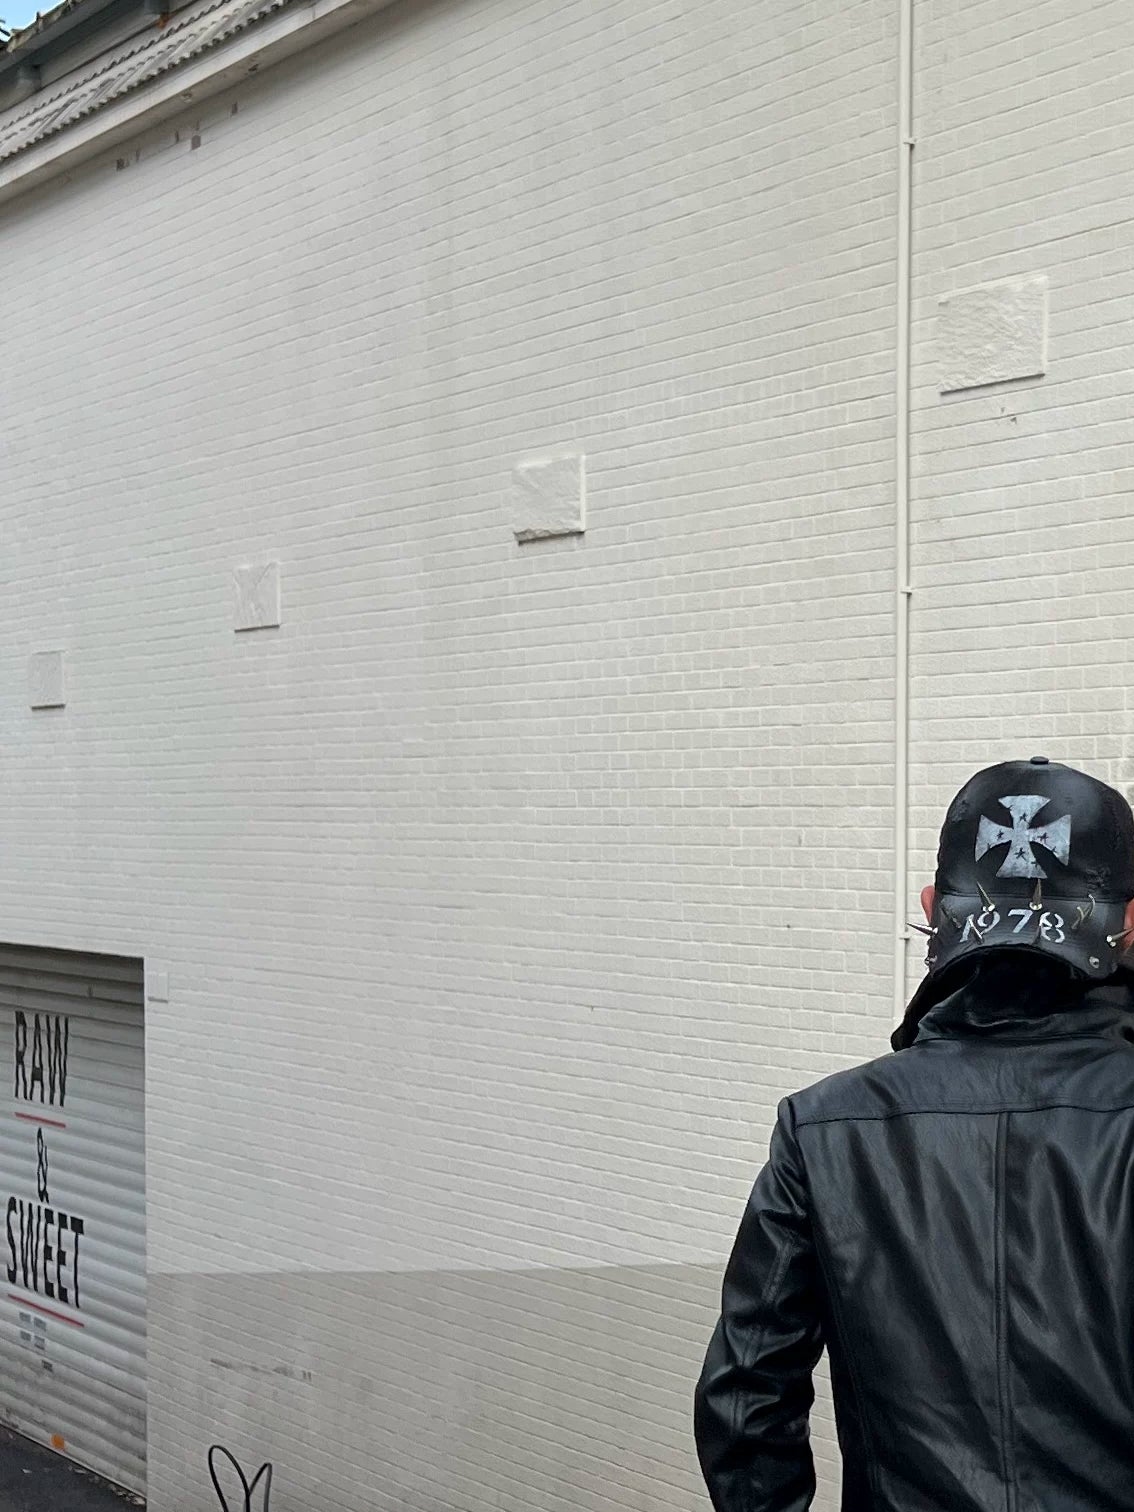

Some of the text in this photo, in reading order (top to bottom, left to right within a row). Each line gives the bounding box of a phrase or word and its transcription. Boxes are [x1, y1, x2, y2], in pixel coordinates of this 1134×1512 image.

[14, 1011, 69, 1107] RAW
[37, 1127, 50, 1203] &
[6, 1196, 85, 1309] SWEET
